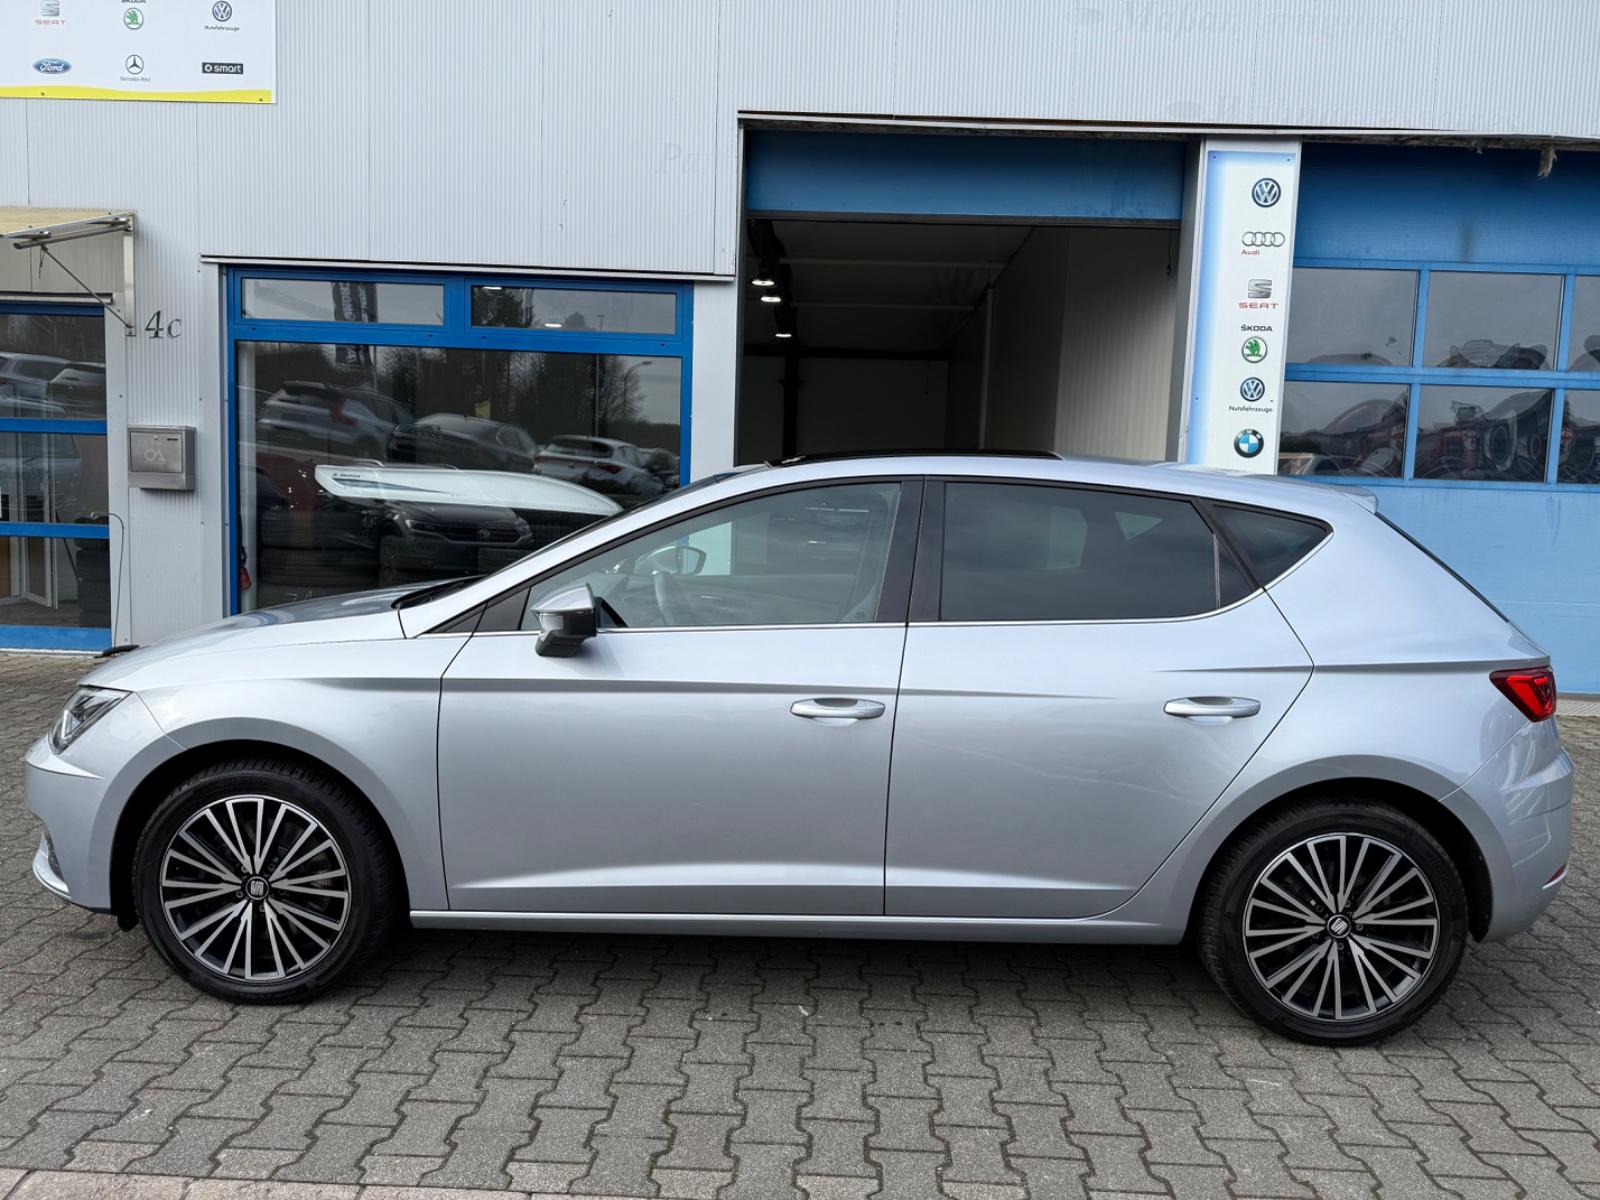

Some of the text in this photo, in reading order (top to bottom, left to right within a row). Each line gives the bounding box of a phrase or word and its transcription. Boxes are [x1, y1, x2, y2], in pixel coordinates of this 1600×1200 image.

[40, 61, 65, 71] Ford
[214, 65, 242, 73] smart
[145, 310, 182, 339] 4c
[1229, 405, 1273, 413] Nutzfahrzeuge
